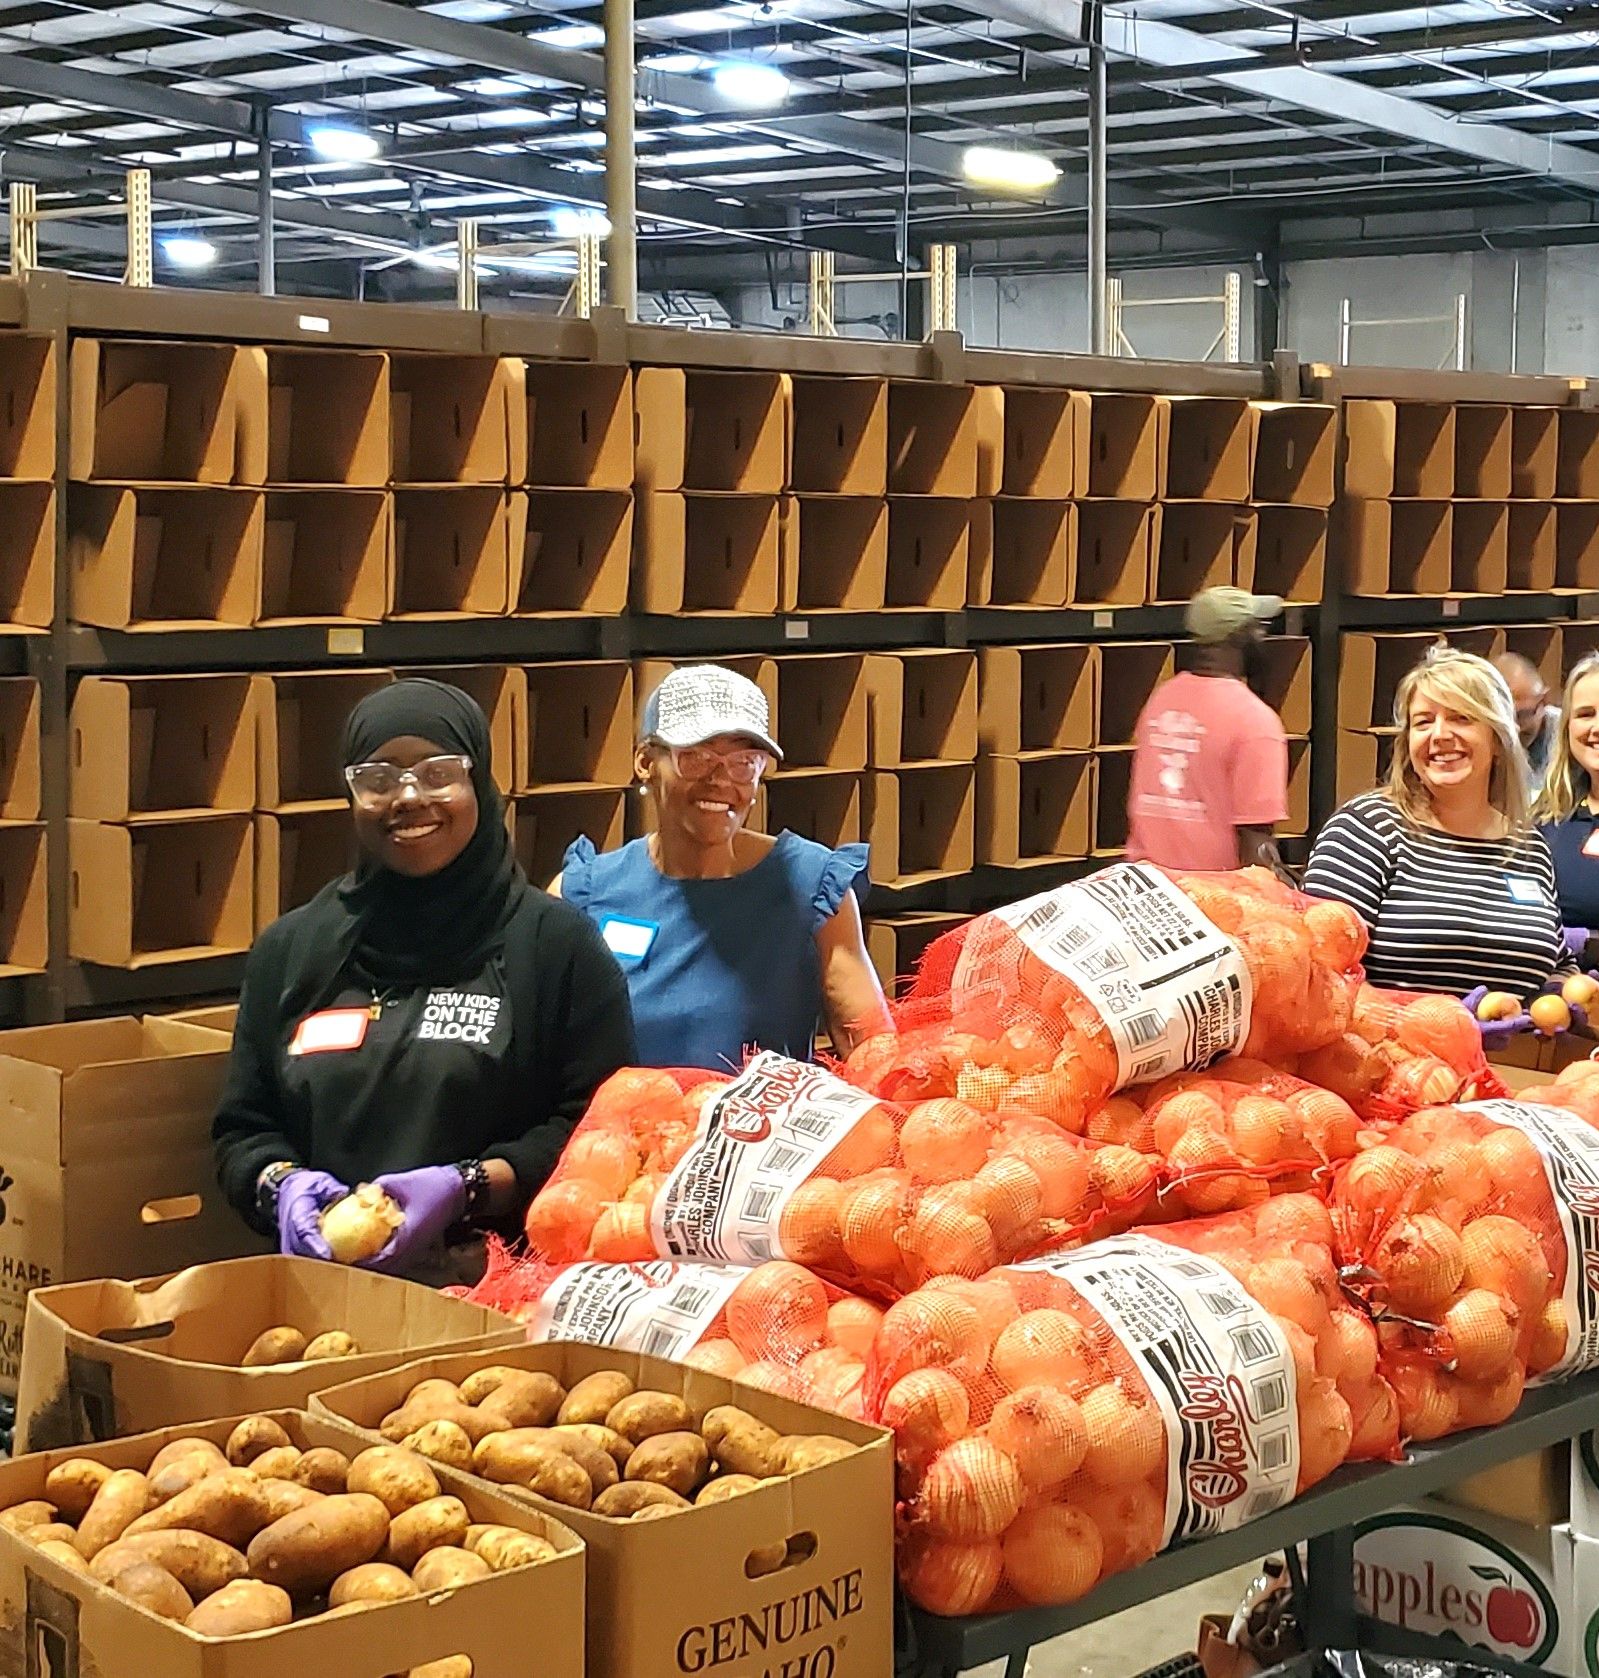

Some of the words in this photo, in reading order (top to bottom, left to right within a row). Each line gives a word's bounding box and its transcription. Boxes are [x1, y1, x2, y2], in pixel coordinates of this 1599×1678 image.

[424, 1005, 455, 1021] ON
[457, 1006, 498, 1026] THE
[426, 993, 464, 1006] NEW
[465, 994, 500, 1010] KIDS
[1203, 988, 1220, 1033] CHARLES
[418, 1021, 492, 1044] BLOCK
[693, 1150, 715, 1204] JOHNSON
[701, 1178, 722, 1234] COMPANY
[2, 1256, 52, 1283] HARE
[586, 1306, 612, 1341] MPANY
[1178, 1371, 1259, 1509] Charley
[1352, 1560, 1484, 1628] apples
[677, 1568, 863, 1673] GENUINE
